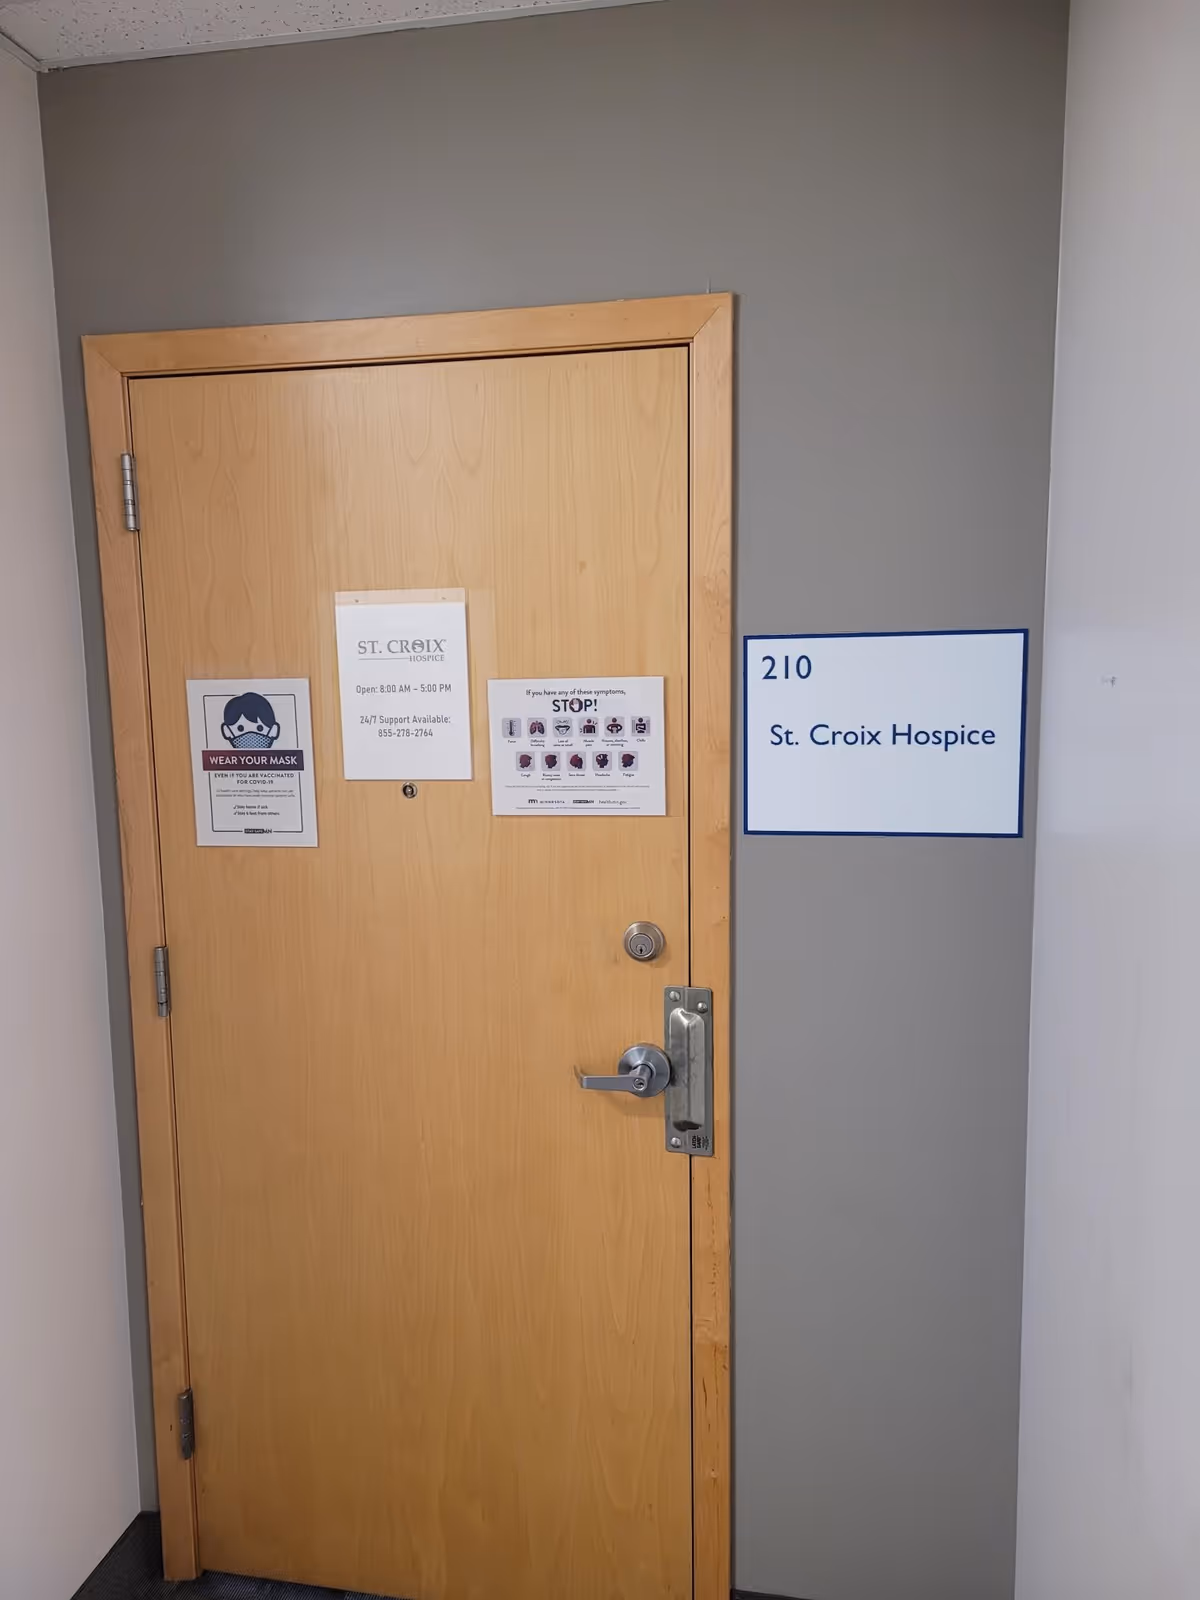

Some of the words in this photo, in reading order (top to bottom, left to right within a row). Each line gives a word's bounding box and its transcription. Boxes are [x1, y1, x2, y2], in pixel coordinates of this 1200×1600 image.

[358, 640, 382, 654] ST.
[387, 639, 445, 654] CROIX
[762, 655, 812, 680] 210
[356, 685, 378, 695] Open:
[380, 684, 396, 693] 8:00
[398, 684, 410, 692] AM
[420, 684, 437, 692] 5:00
[440, 684, 452, 692] PM
[552, 698, 598, 712] STOP!
[360, 716, 376, 725] 24/7
[380, 715, 410, 726] Support
[412, 715, 451, 724] Available:
[378, 728, 433, 738] 855-278-2764
[770, 724, 800, 746] St.
[809, 724, 882, 746] Croix
[892, 724, 996, 752] Hospice
[210, 756, 238, 765] WEAR
[240, 756, 268, 765] YOUR
[270, 756, 297, 765] MASK
